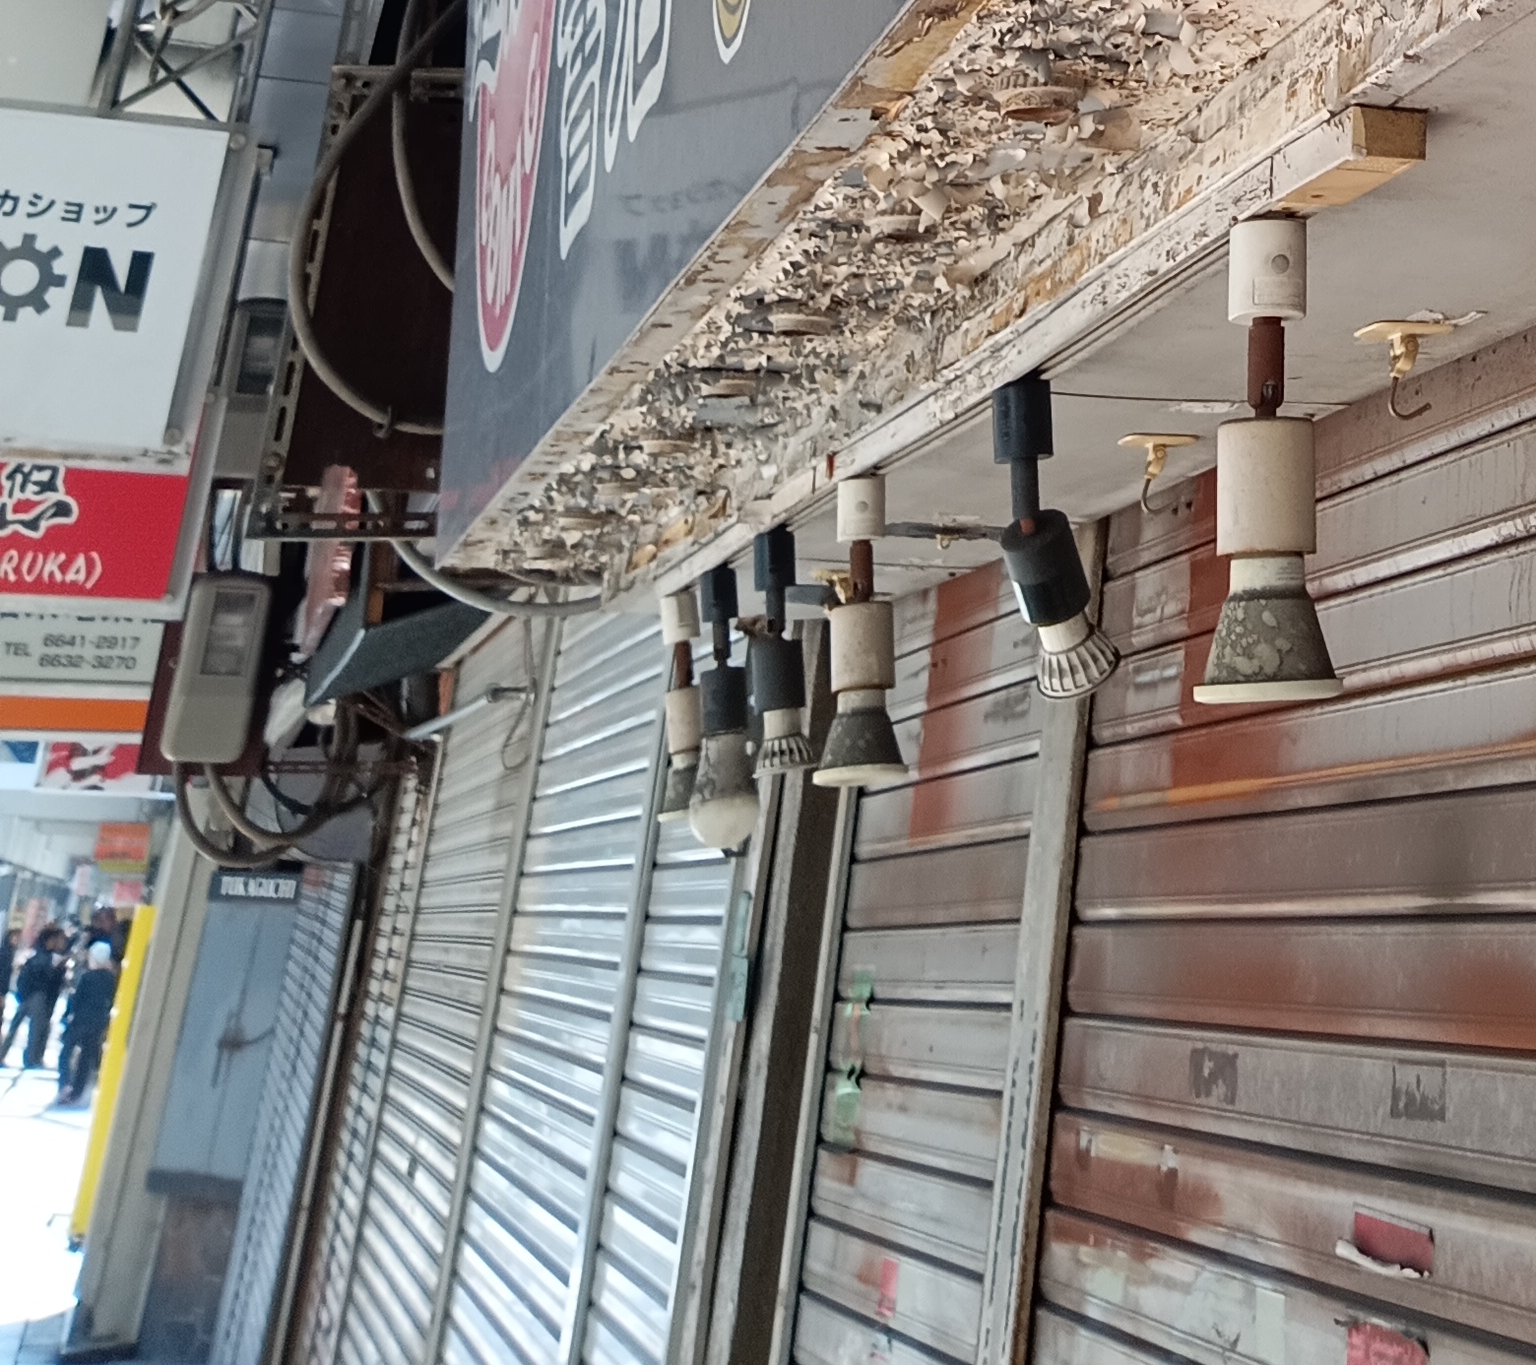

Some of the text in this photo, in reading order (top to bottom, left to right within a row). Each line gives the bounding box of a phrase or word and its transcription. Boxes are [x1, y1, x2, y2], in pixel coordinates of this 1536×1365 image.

[0, 188, 158, 228] カショップ
[4, 641, 32, 657] TEL
